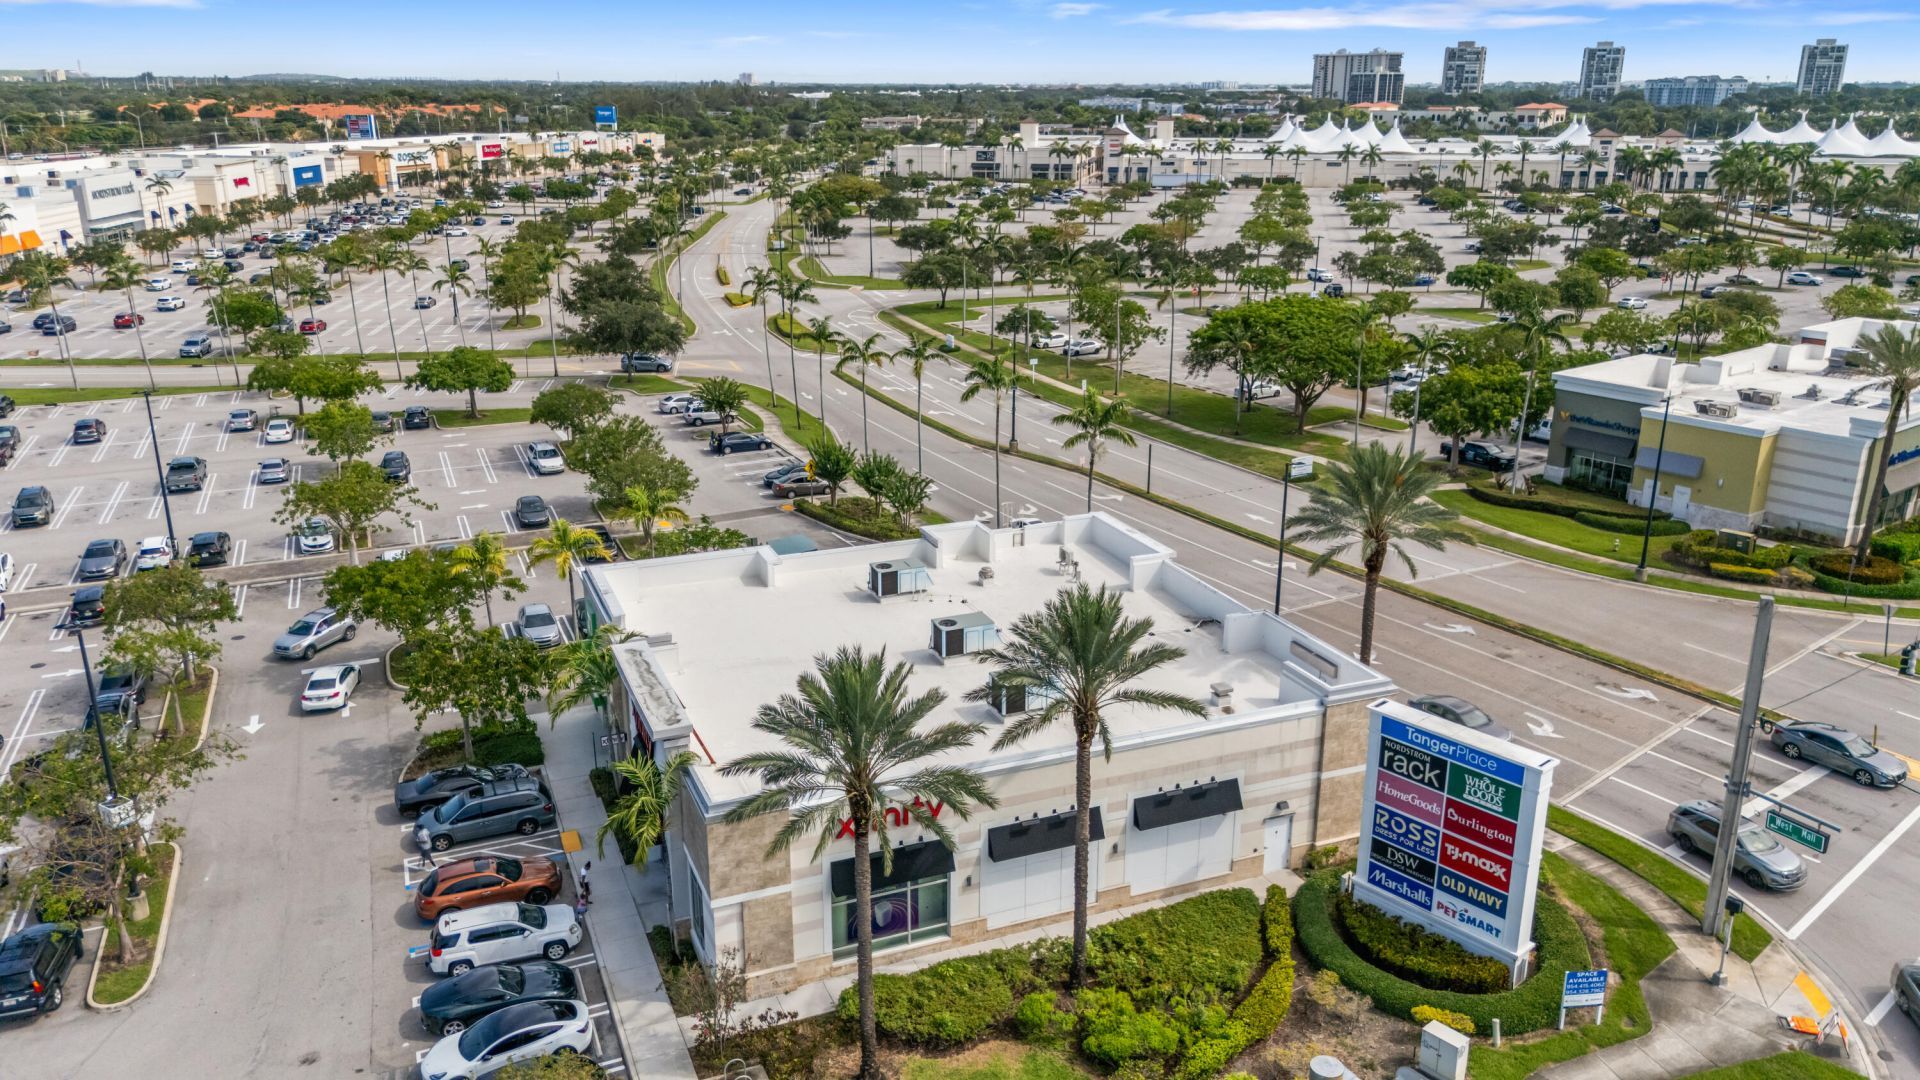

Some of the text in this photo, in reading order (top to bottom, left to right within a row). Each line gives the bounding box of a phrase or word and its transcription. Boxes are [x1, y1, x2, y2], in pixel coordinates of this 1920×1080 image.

[1384, 740, 1431, 763] NORDSTROM
[1383, 750, 1441, 788] rack
[1378, 781, 1441, 816] HomeGoods
[1464, 774, 1506, 799] WHOLE
[1464, 786, 1503, 808] FOODS
[1374, 825, 1436, 857] DRESS FOR LESS
[1375, 808, 1437, 849] ROSS
[1447, 807, 1513, 845] Burlington
[1775, 816, 1816, 843] West Mall
[1387, 846, 1419, 870] DSW
[1368, 869, 1431, 907] Marshalls
[1441, 874, 1504, 911] OLD NAVY
[1568, 976, 1605, 984] AVAILABLE
